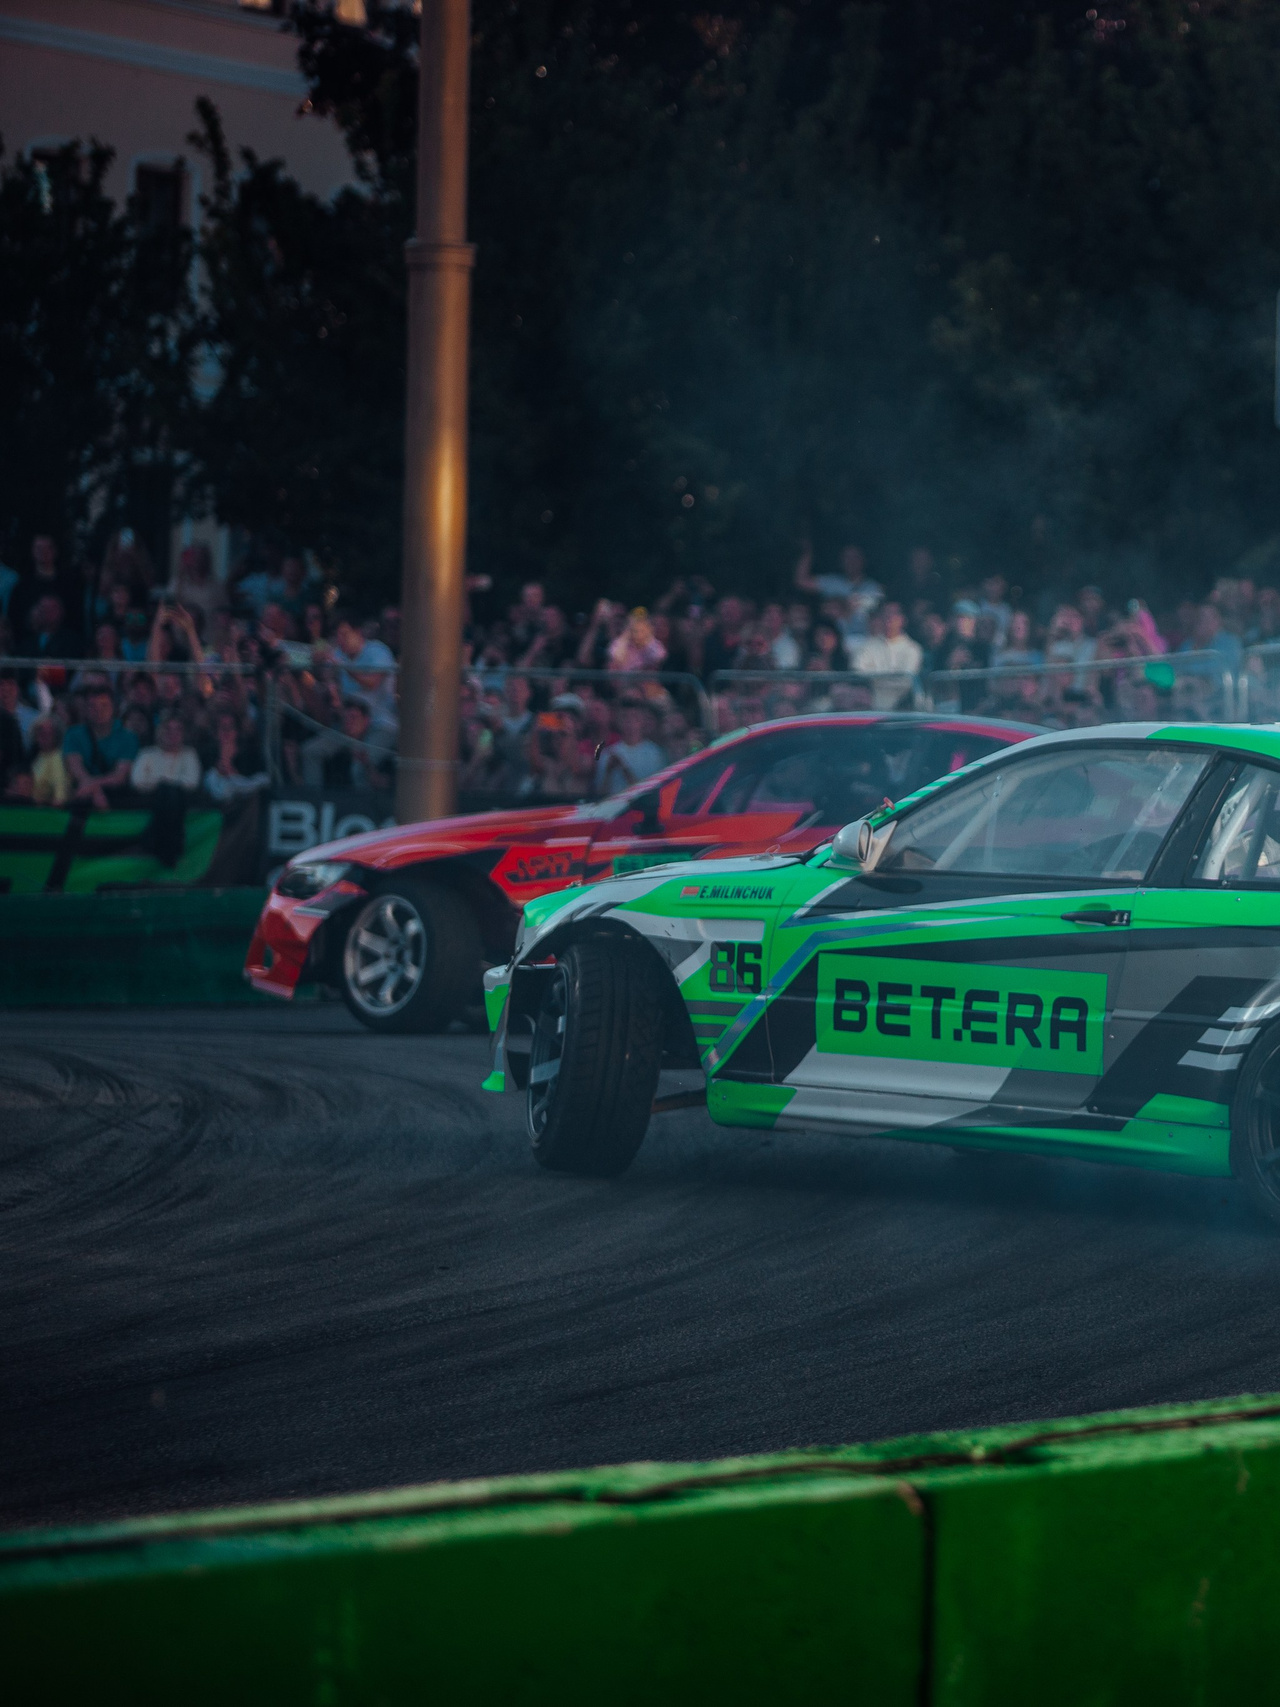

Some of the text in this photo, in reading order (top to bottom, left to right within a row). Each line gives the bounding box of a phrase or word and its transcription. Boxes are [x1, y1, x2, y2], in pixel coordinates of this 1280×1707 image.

[700, 885, 774, 899] E.MILINCHUK
[709, 941, 762, 993] 86
[833, 978, 1088, 1052] BET.ERA
